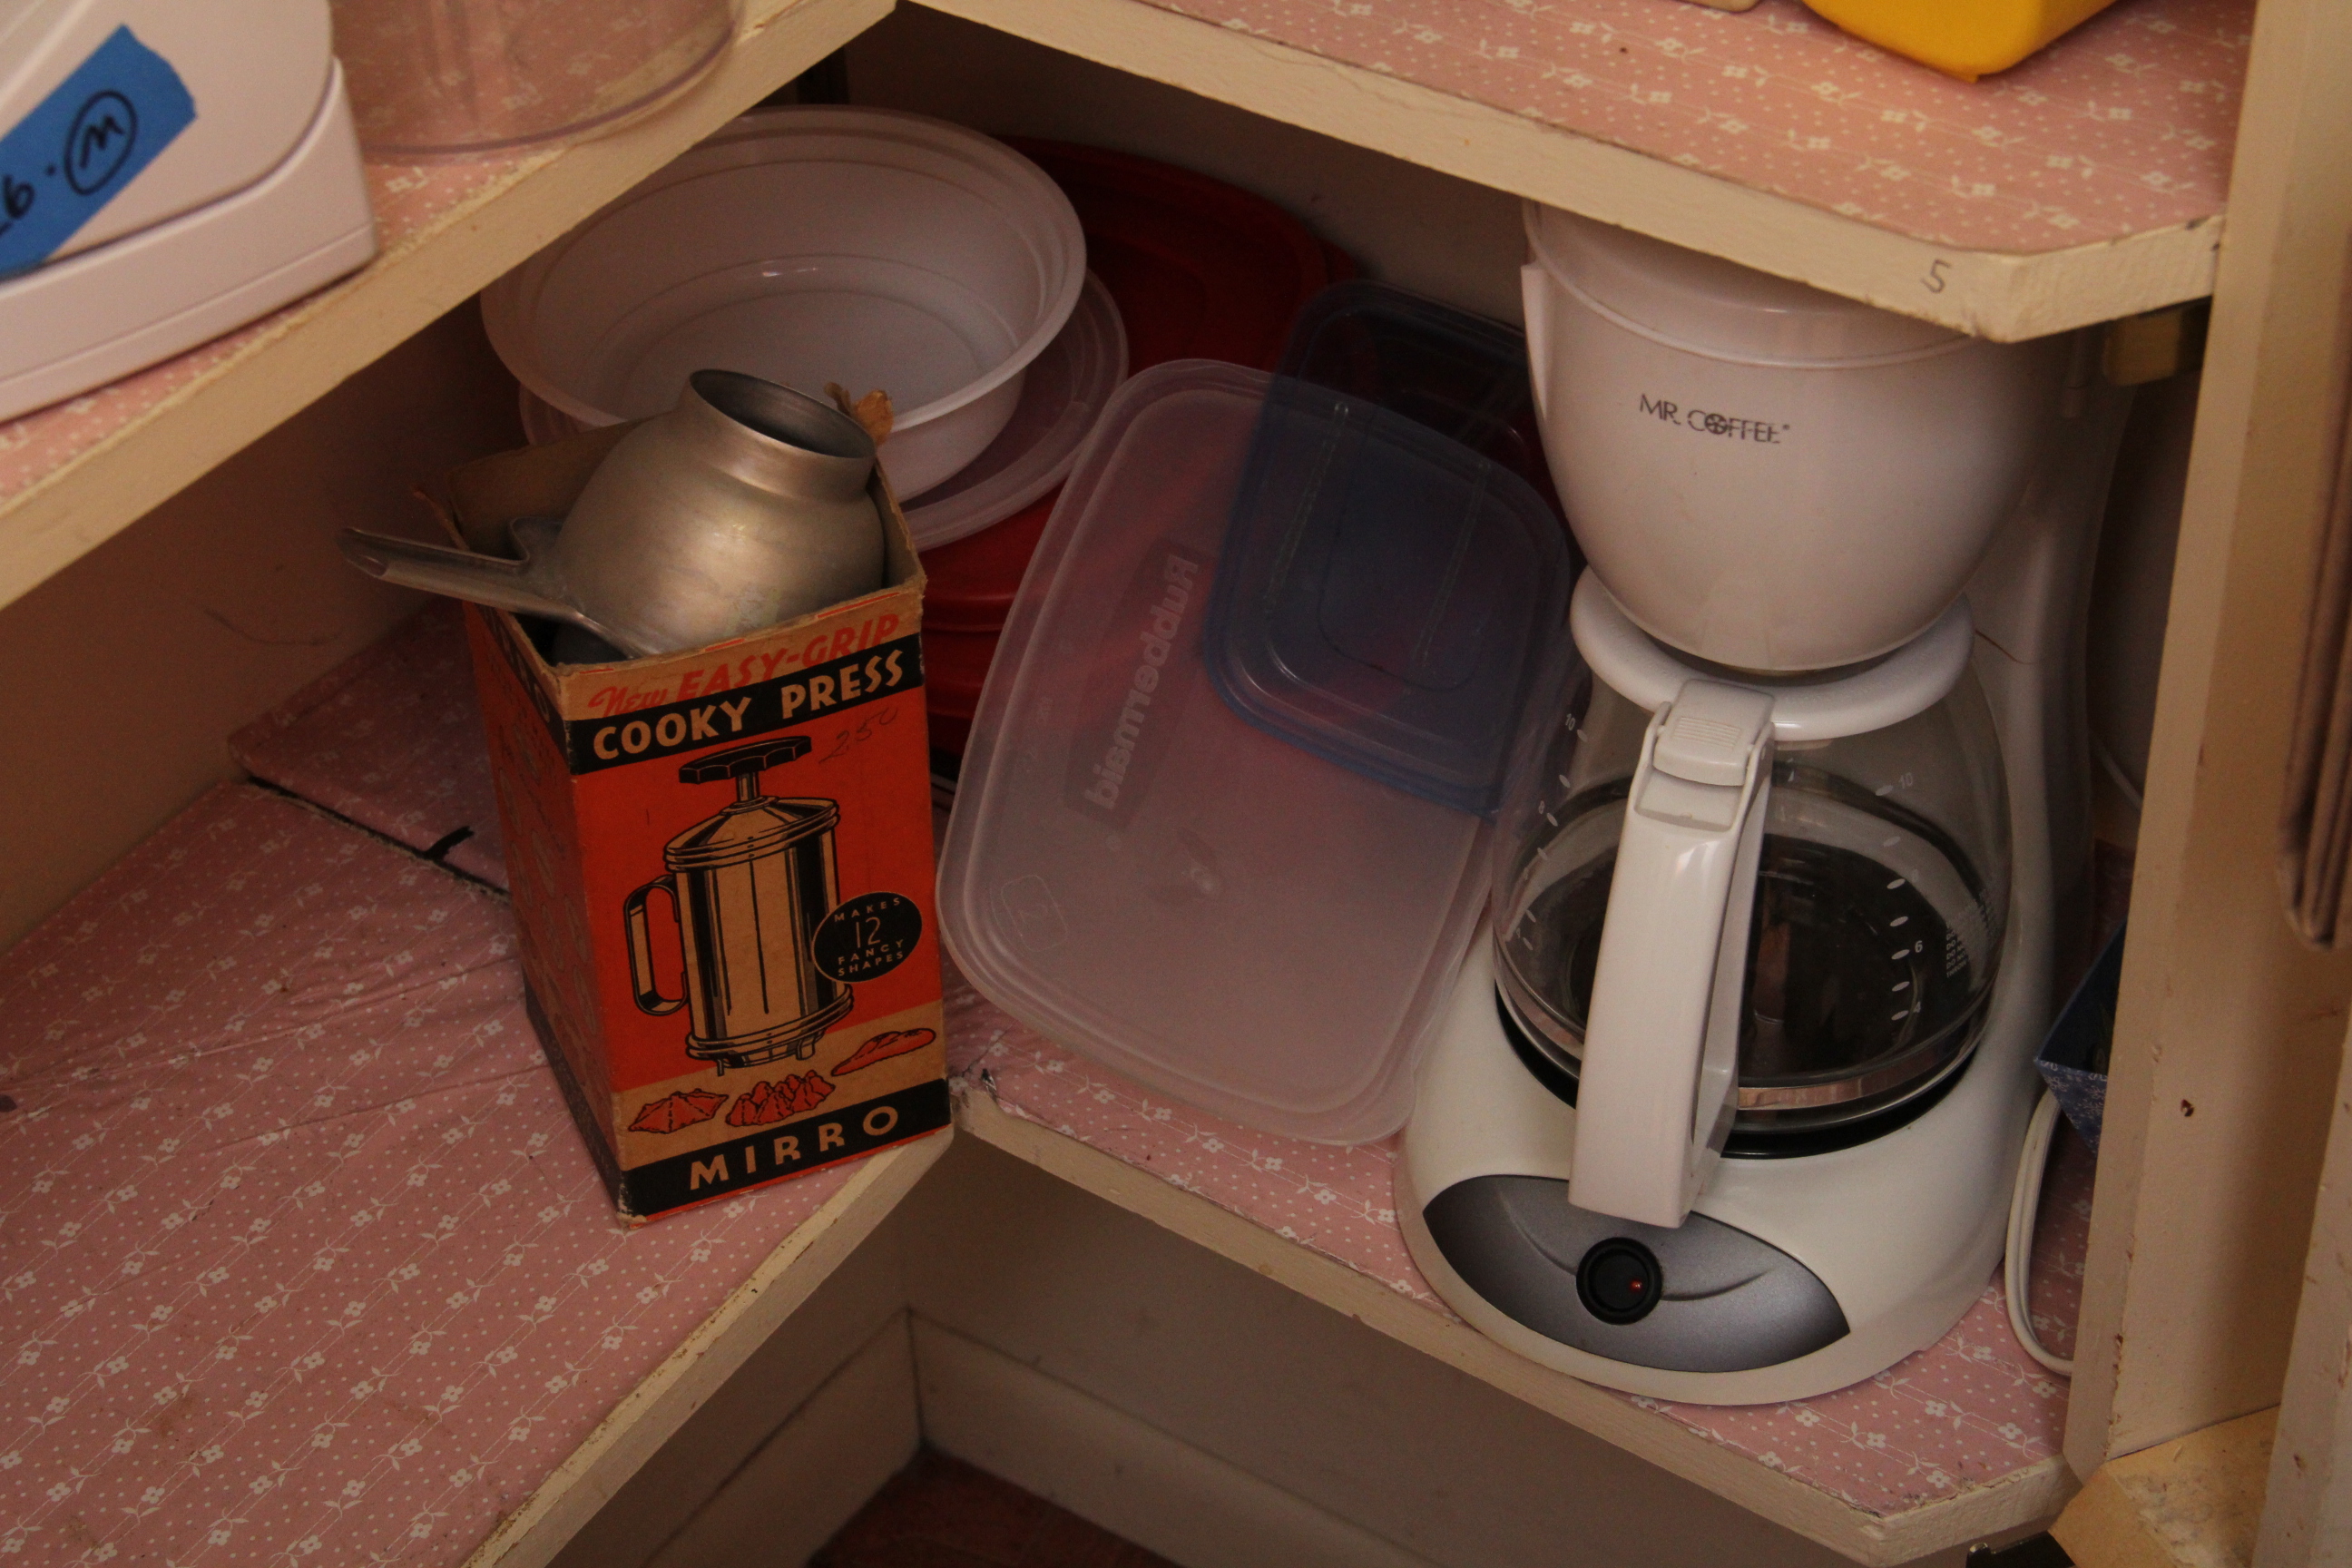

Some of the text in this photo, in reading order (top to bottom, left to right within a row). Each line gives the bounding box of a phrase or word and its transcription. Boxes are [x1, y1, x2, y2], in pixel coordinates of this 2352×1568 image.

[1919, 259, 1952, 295] 5
[674, 613, 900, 702] EASY-GRIP
[593, 696, 752, 761] COOKY
[781, 648, 904, 720] PRESS
[833, 897, 902, 922] MAKES
[854, 916, 881, 949] 12
[1914, 939, 1923, 954] 6
[837, 938, 906, 965] FANCY
[837, 951, 905, 977] SHAPES
[689, 1104, 899, 1191] MIRRO
